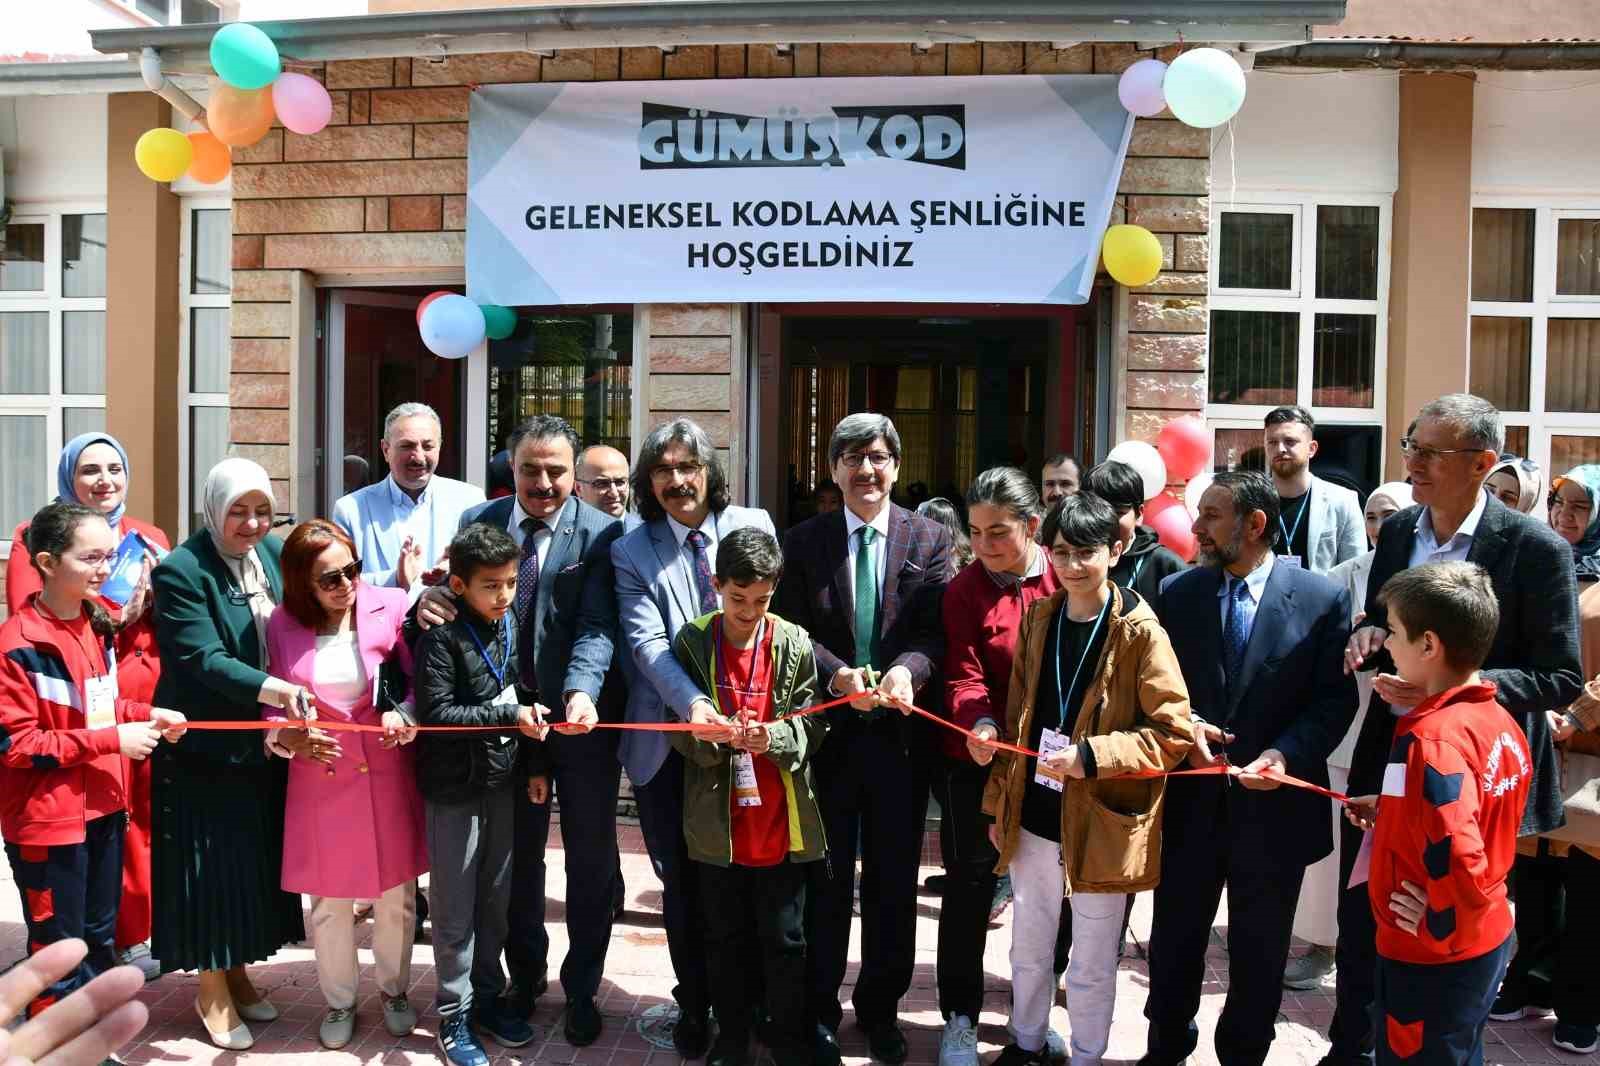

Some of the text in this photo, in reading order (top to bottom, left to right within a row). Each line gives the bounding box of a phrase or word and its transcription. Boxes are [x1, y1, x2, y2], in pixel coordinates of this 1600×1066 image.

[638, 105, 964, 170] GÜMÜŞKOD
[525, 192, 1085, 235] GELENEKSEL KODLAMA ŞENLİĞİNE
[688, 234, 914, 276] HOŞGELDİNİZ
